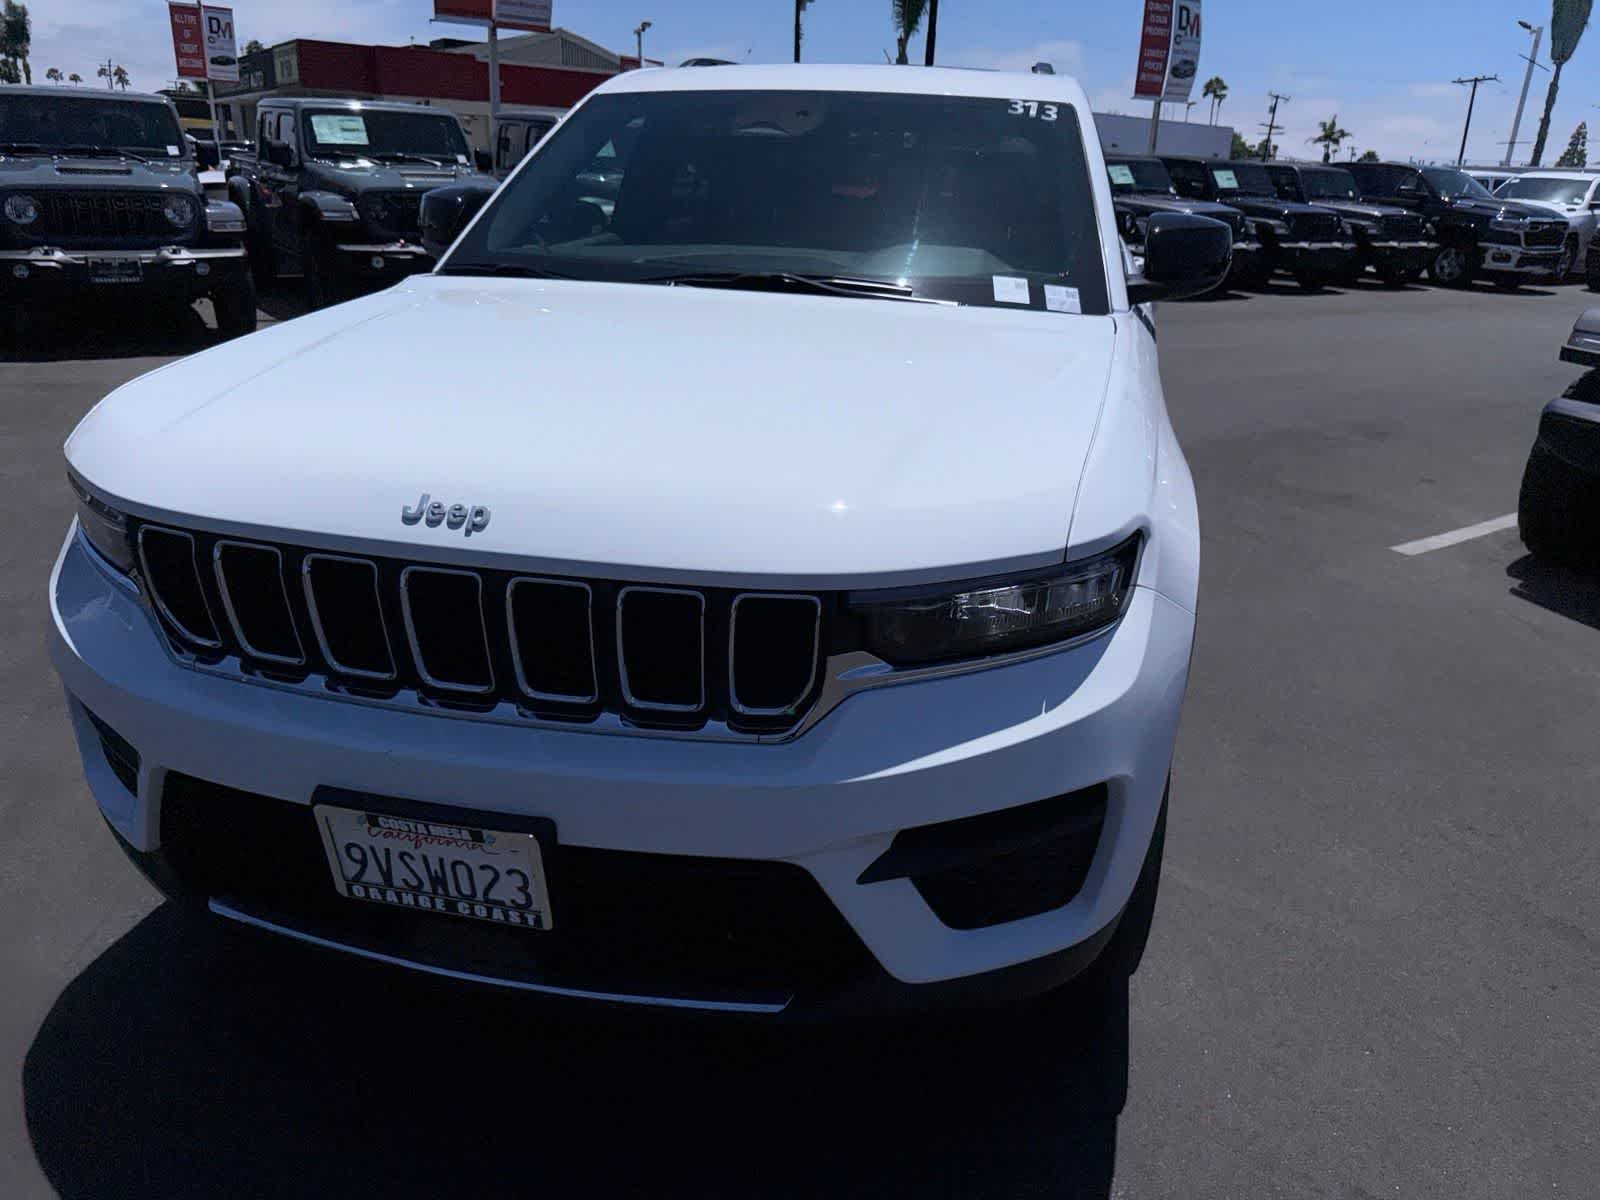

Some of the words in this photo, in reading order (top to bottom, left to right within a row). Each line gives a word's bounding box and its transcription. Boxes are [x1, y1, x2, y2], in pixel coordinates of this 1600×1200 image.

[1008, 99, 1058, 121] 313
[402, 494, 491, 538] Jeep
[377, 817, 428, 834] COSTA
[345, 842, 534, 909] 9VSW023
[351, 883, 447, 911] ORANGE
[456, 901, 537, 928] COAST
